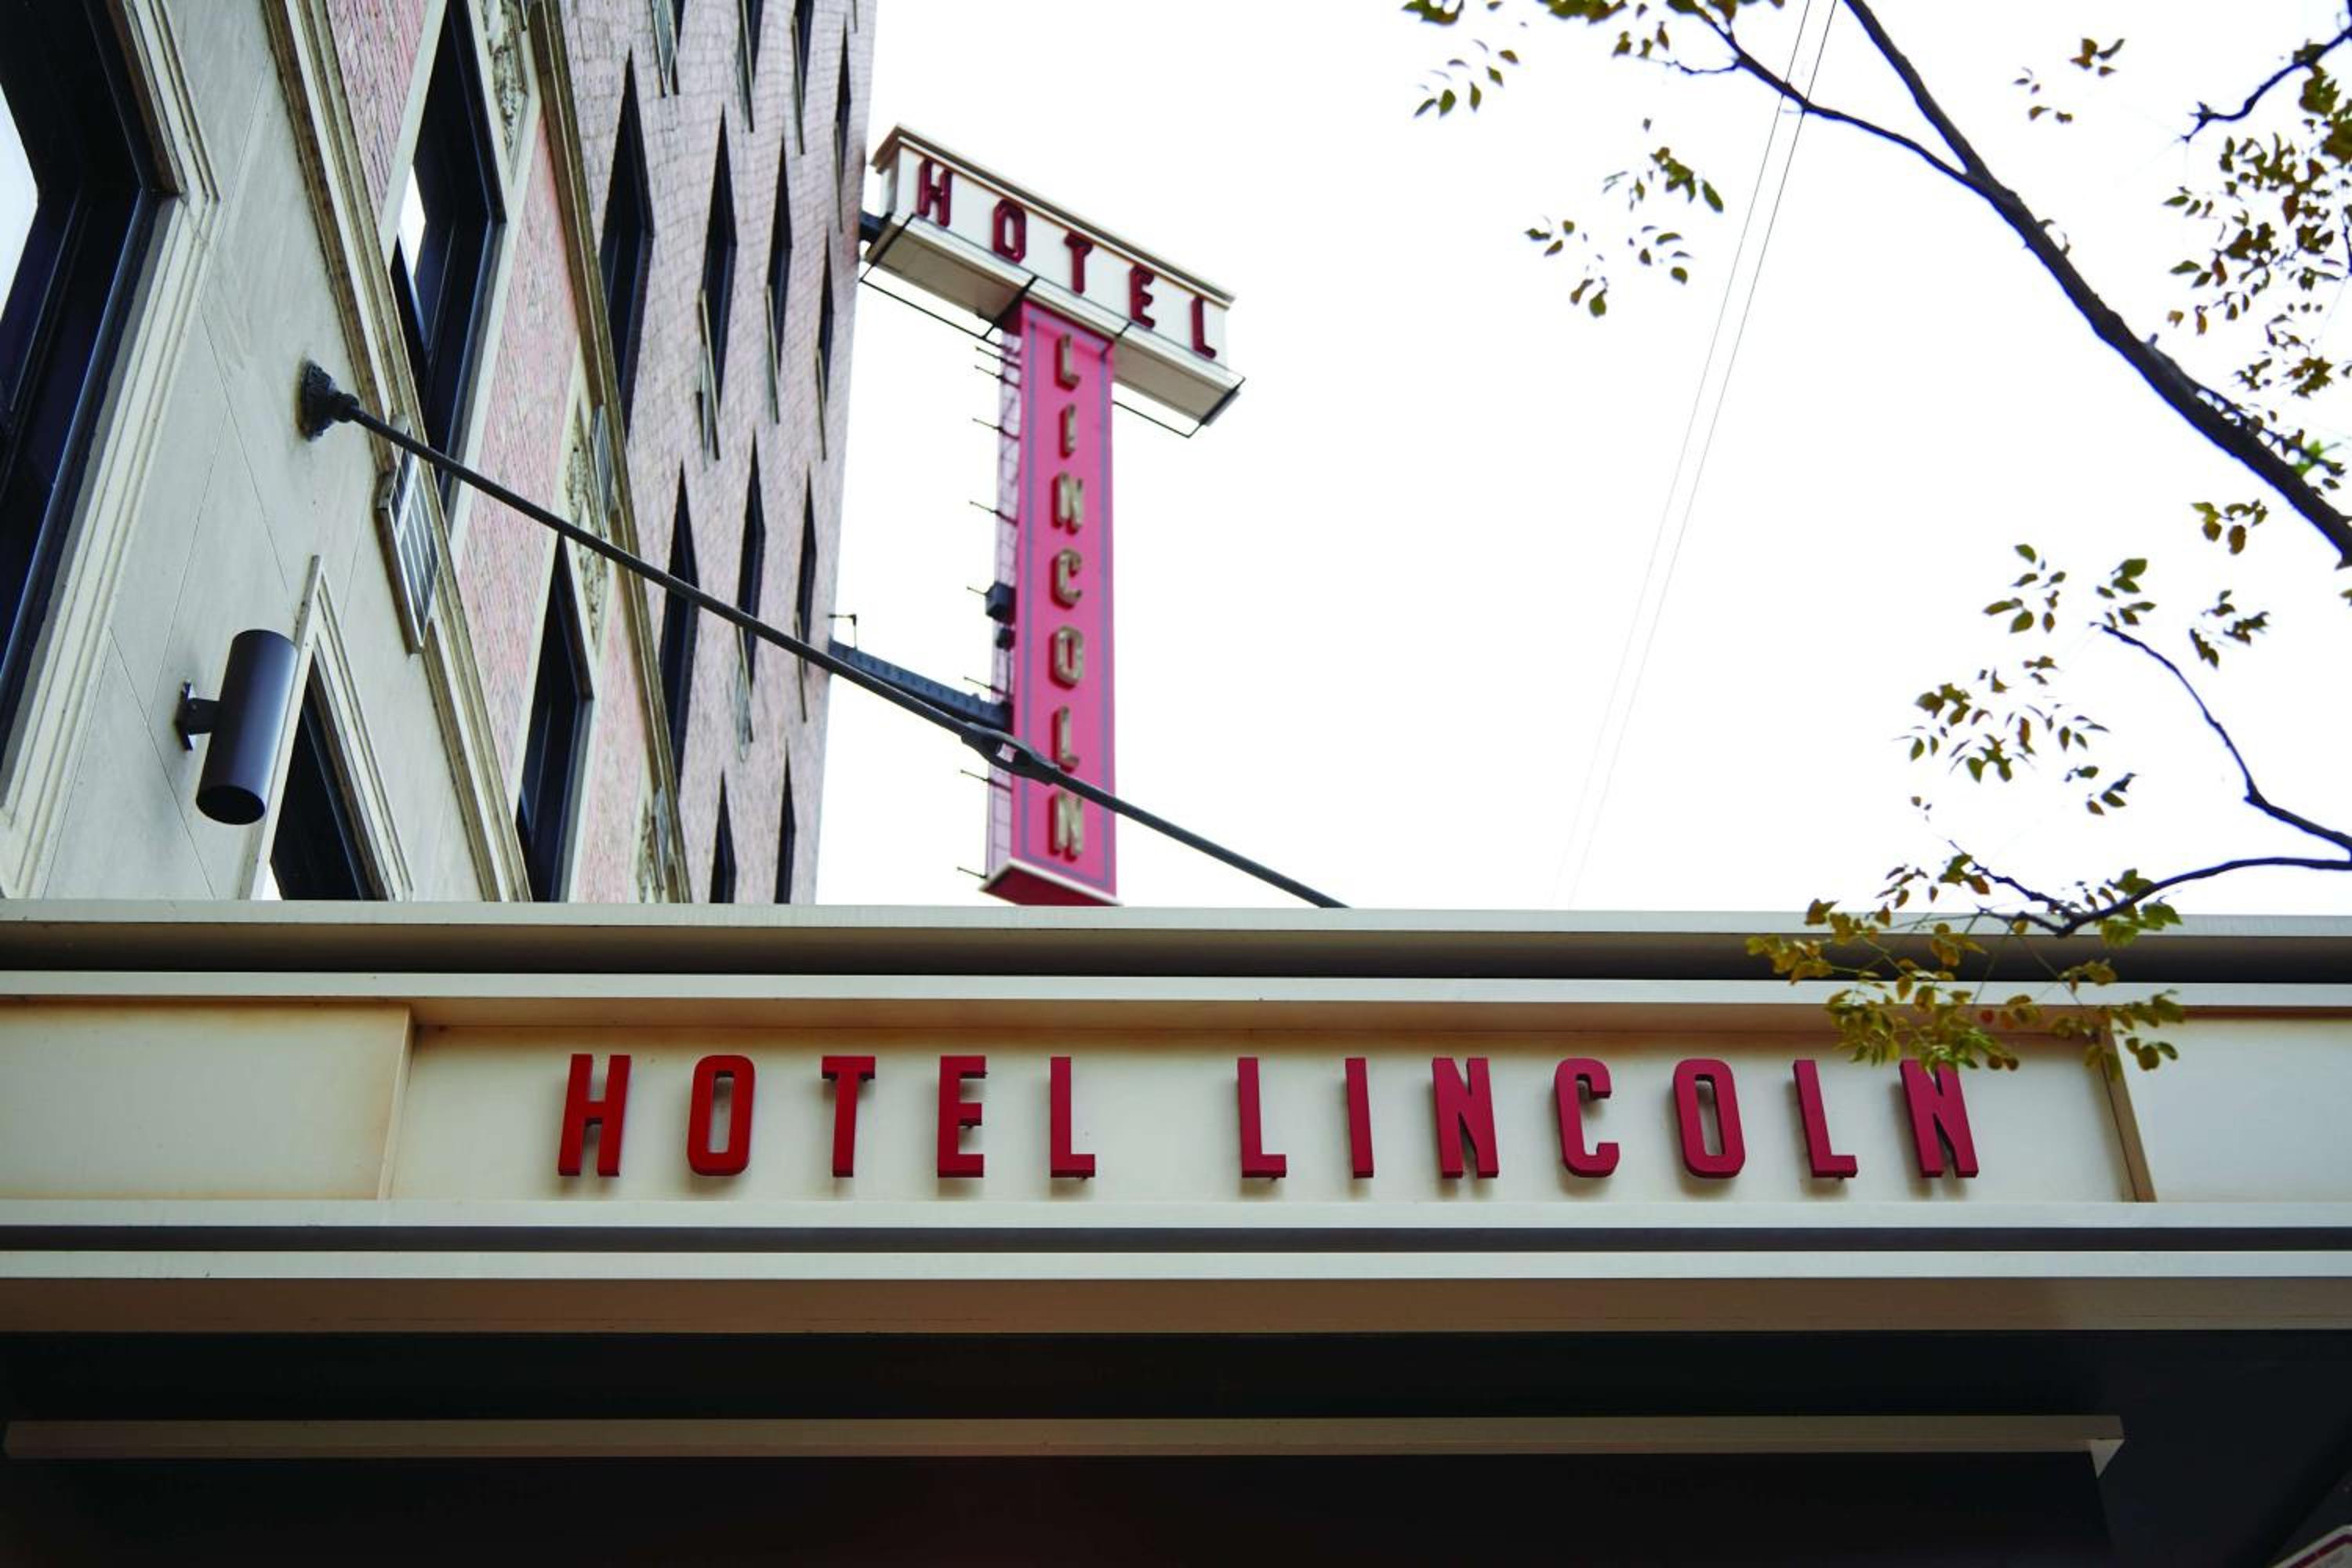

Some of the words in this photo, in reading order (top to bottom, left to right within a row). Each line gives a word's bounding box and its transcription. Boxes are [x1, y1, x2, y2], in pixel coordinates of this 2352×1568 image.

[917, 159, 1217, 358] HOTEL
[1048, 333, 1084, 862] LINCOLN
[557, 1053, 1095, 1178] HOTEL
[1236, 1056, 1979, 1178] LINCOLN
